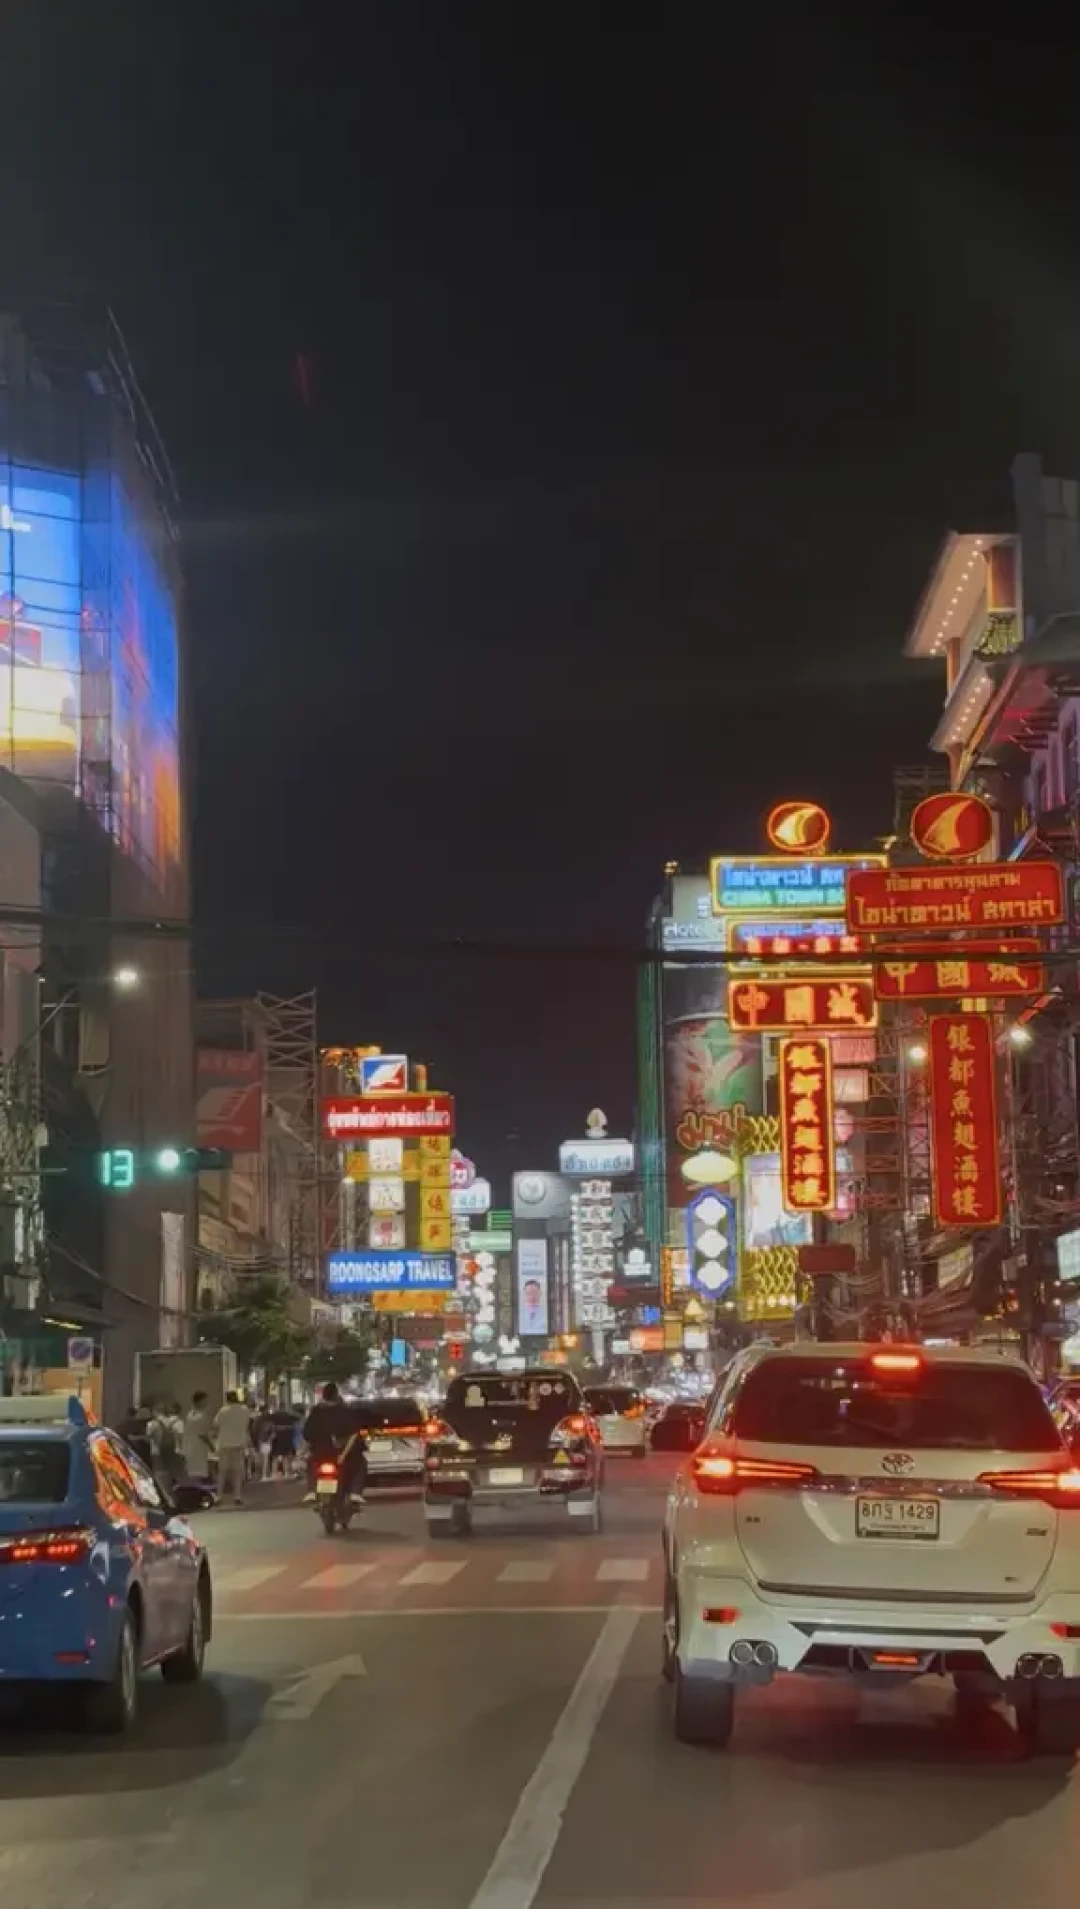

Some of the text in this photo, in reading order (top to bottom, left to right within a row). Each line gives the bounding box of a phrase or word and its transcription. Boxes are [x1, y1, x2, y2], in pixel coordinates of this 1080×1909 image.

[102, 1149, 133, 1187] 13
[329, 1260, 453, 1283] ROONGSARP TRAVEL
[900, 1504, 934, 1520] 1429
